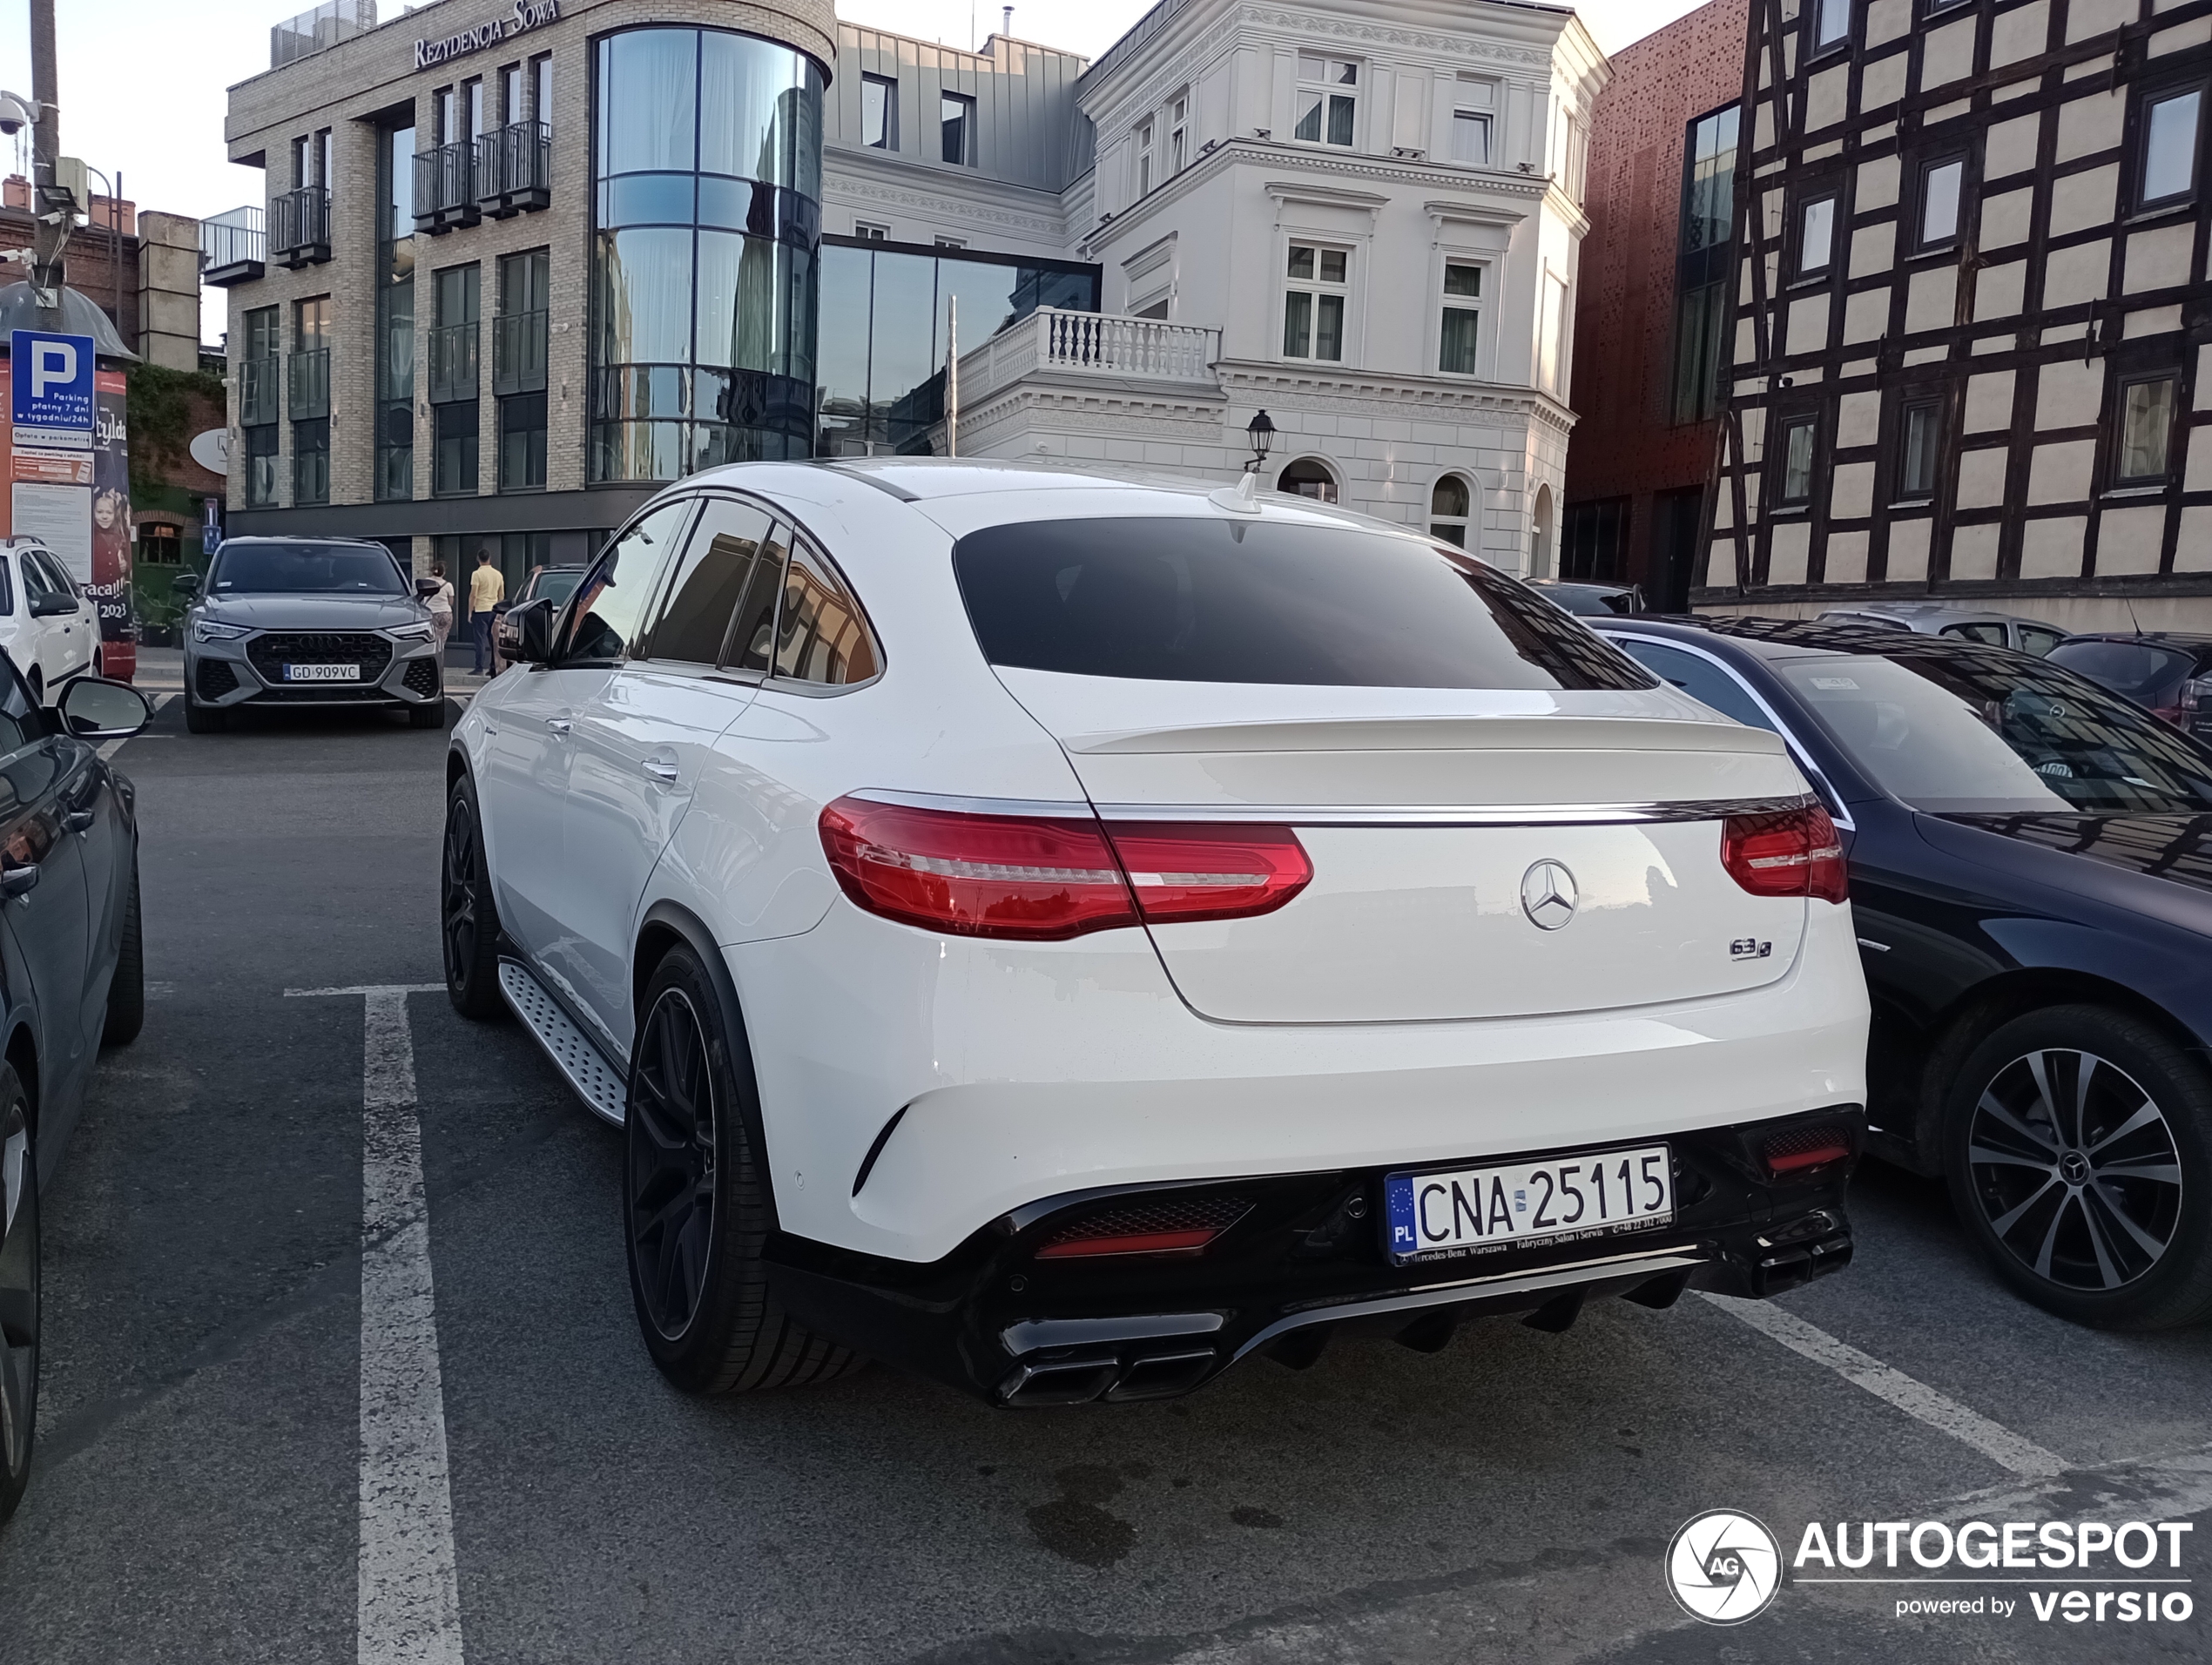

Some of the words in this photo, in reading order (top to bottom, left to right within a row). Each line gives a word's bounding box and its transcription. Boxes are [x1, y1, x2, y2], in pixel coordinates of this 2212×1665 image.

[31, 340, 77, 398] P
[54, 392, 89, 405] Parking
[31, 402, 62, 414] płatny
[74, 405, 89, 414] dni
[27, 412, 89, 424] tygodniu/24h
[97, 413, 126, 445] tylda
[100, 603, 126, 618] 2023
[293, 666, 311, 678] GD
[315, 666, 356, 678] 909VC
[1730, 938, 1756, 955] 63
[1419, 1174, 1514, 1243] CNA
[1528, 1155, 1665, 1230] 25115
[1394, 1226, 1413, 1244] PL
[1410, 1248, 1467, 1263] Mercedes-Benz
[1469, 1243, 1507, 1256] Warszawa
[1516, 1236, 1554, 1250] Fabryczny
[1554, 1232, 1575, 1244] Salon
[1580, 1228, 1604, 1240] Serwis
[1633, 1221, 1642, 1230] 22
